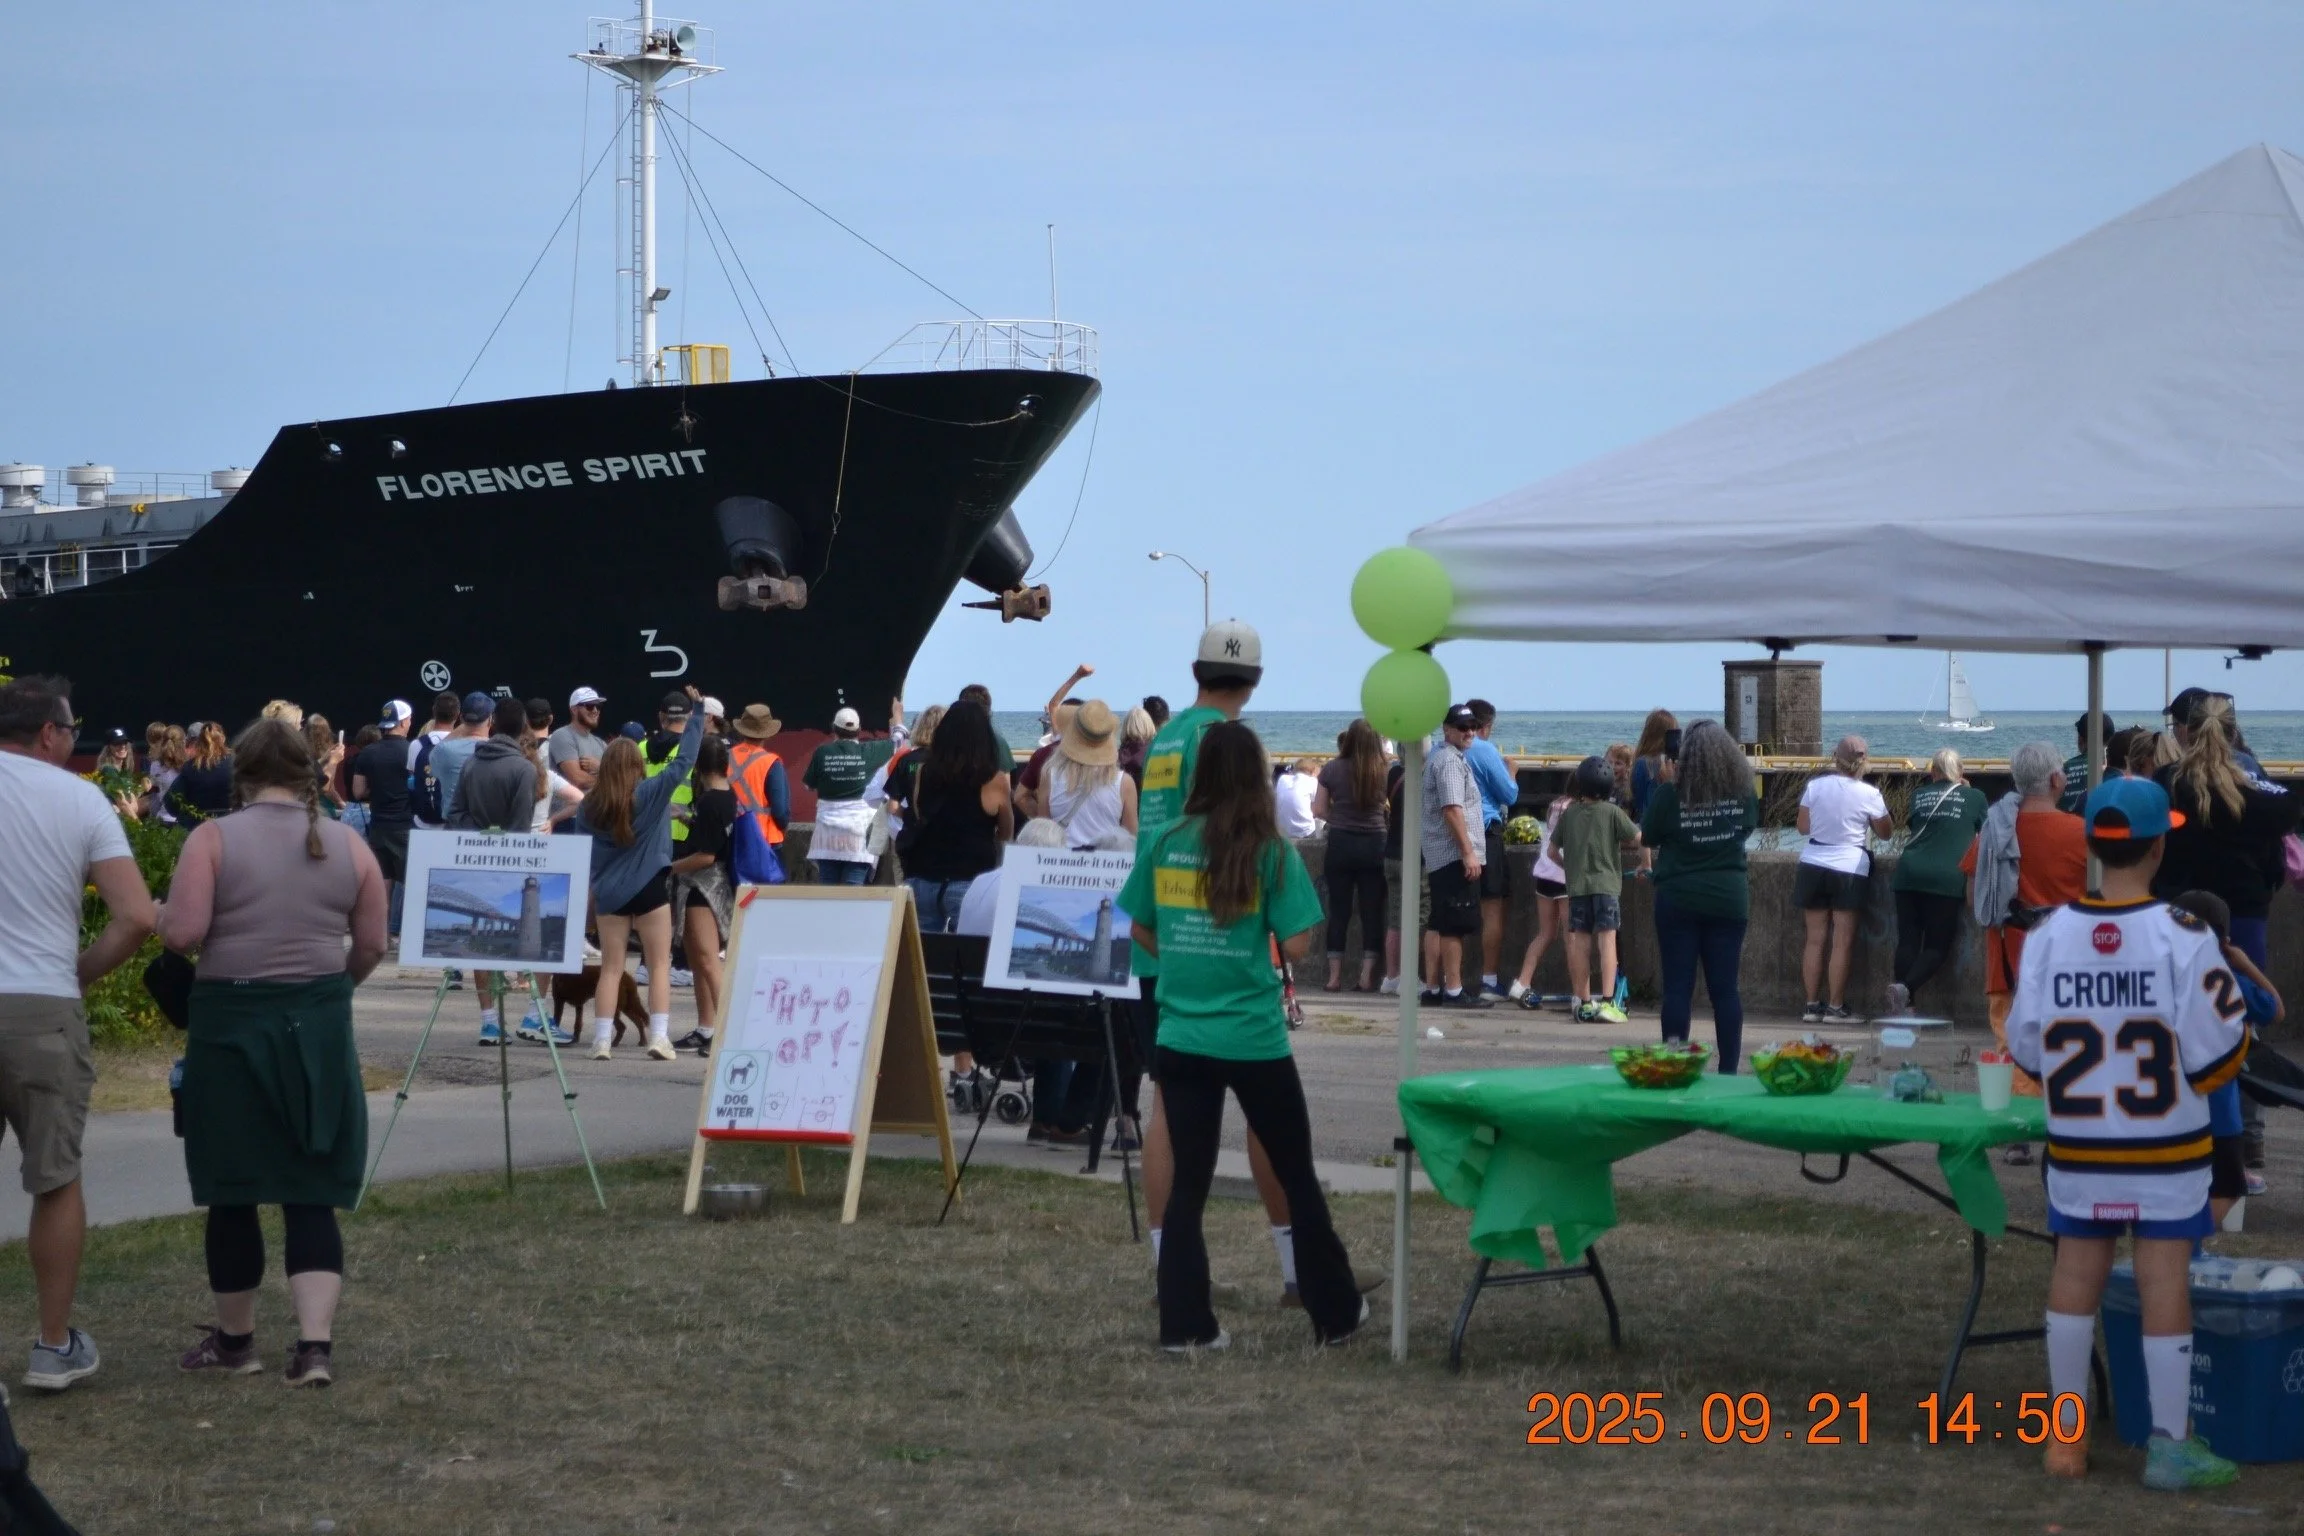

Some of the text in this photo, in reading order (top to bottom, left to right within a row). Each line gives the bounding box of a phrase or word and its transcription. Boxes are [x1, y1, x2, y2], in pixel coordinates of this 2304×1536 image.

[376, 449, 706, 501] FLORENCE SPIRIT
[1224, 638, 1241, 658] NY
[457, 836, 548, 849] I made it to the
[454, 854, 547, 869] LIGHTHOUSE!
[1037, 854, 1057, 867] You
[1060, 856, 1090, 868] made
[1092, 857, 1100, 868] it
[1102, 858, 1114, 869] to
[2094, 932, 2120, 945] STOP
[2053, 970, 2157, 1008] CROMIE
[767, 977, 851, 1026] PHOTO
[776, 1020, 850, 1068] OP!
[2044, 1017, 2179, 1120] 23
[723, 1093, 749, 1106] DOG
[716, 1106, 754, 1118] WATER
